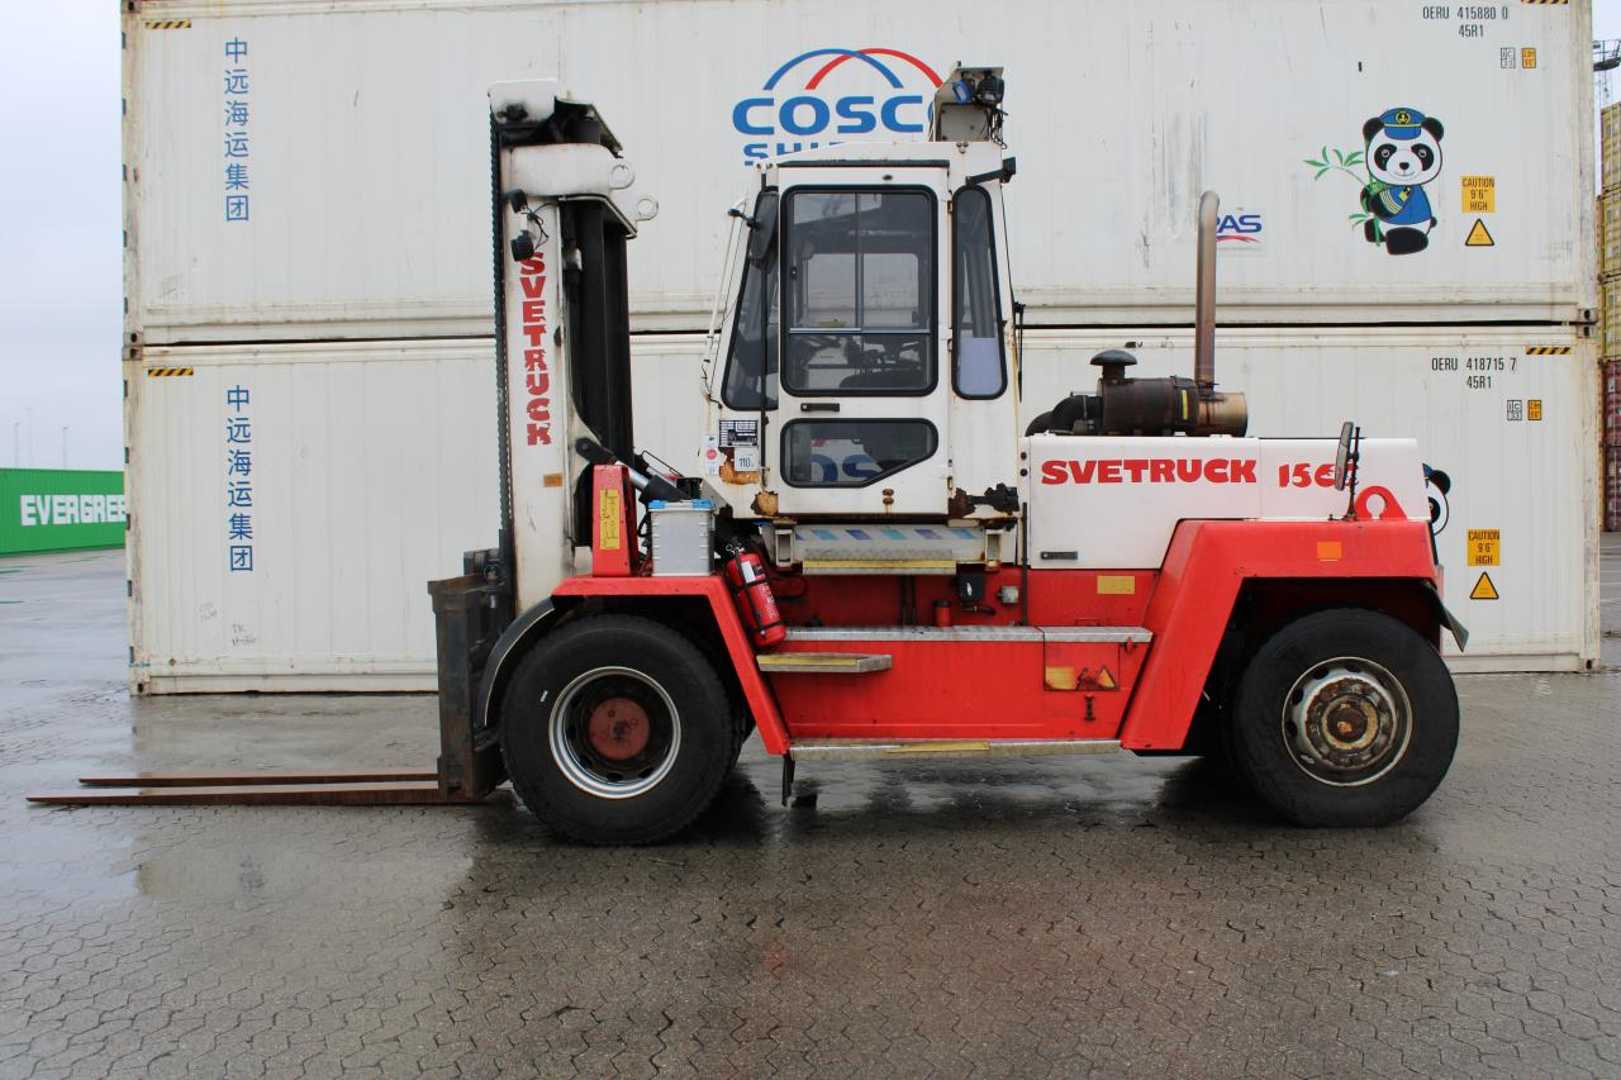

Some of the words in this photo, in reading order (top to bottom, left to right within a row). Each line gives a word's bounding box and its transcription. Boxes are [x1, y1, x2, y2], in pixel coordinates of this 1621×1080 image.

[1423, 6, 1449, 19] OERU
[1457, 7, 1496, 20] 415880
[1459, 25, 1483, 37] 45R1
[733, 95, 936, 136] COSC
[224, 37, 249, 222] 中远海运集团
[1463, 178, 1495, 188] CAUTION
[1471, 201, 1488, 211] HIGH
[520, 252, 551, 446] SVETRUCK
[1431, 357, 1458, 371] OERU
[1466, 357, 1504, 371] 418715
[1510, 357, 1517, 371] 7
[1466, 375, 1492, 389] 45R1
[227, 385, 253, 571] 中远海运集团
[1041, 459, 1256, 485] SVETRUCK
[1468, 528, 1500, 541] CAUTION
[1475, 555, 1493, 566] HIGH
